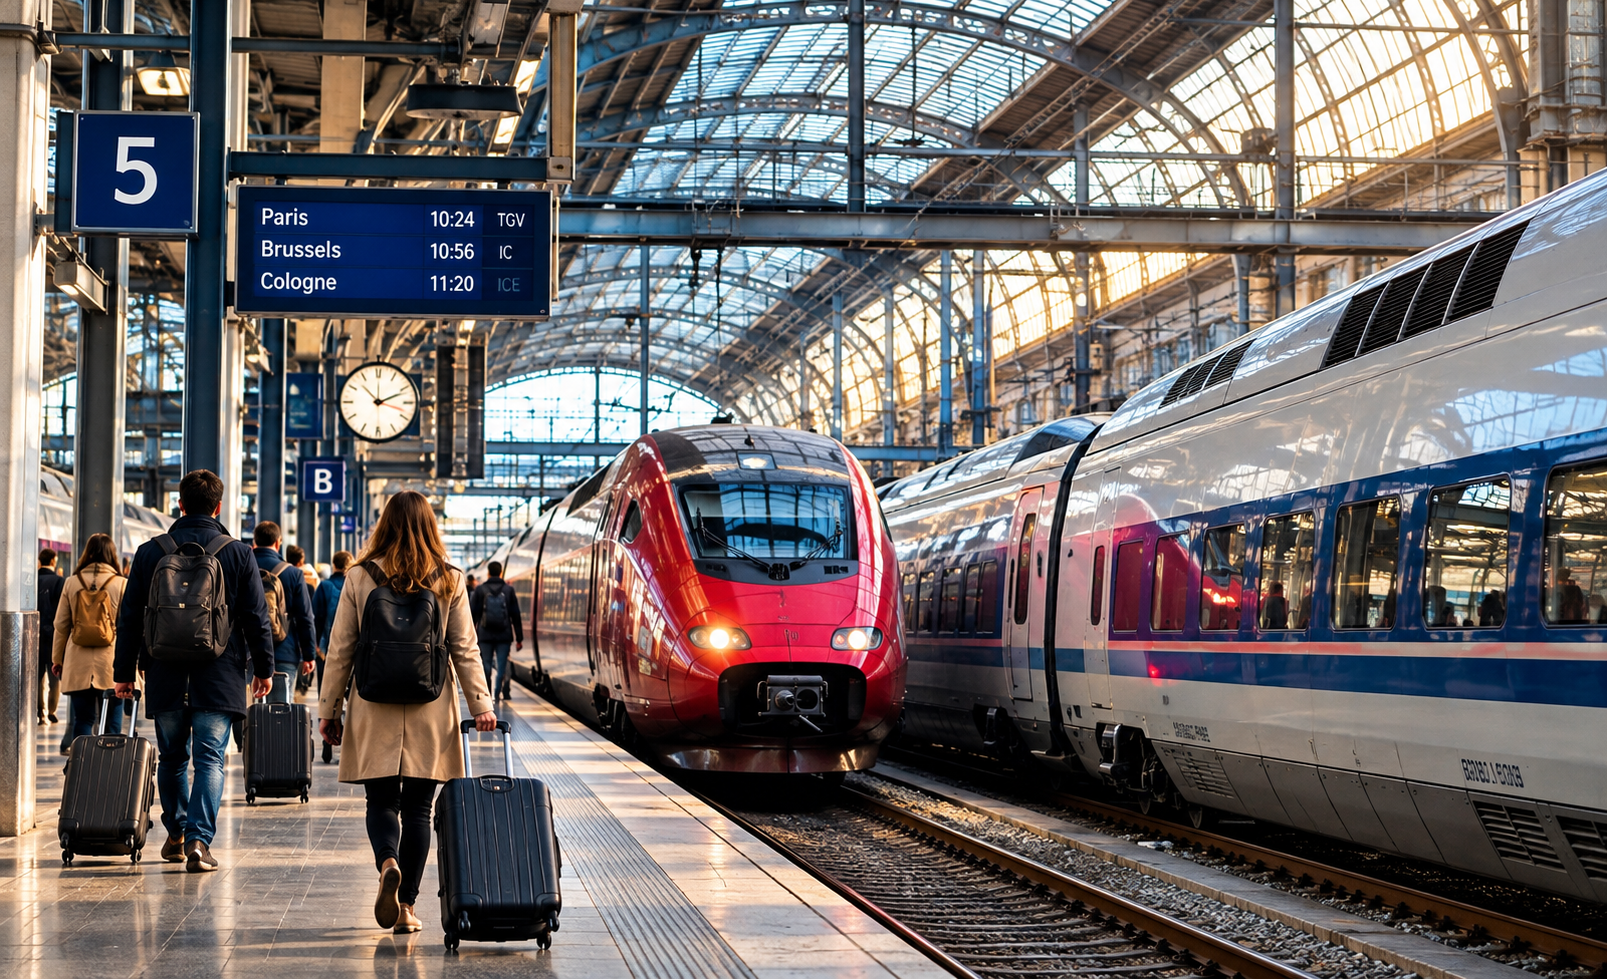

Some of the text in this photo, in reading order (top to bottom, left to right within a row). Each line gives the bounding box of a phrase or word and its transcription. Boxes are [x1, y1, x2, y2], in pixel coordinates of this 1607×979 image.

[114, 136, 158, 205] 5
[261, 208, 526, 228] Paris 10:24 TGV
[261, 239, 513, 260] Brussels 10:56 IC
[261, 271, 520, 294] Cologne 11:20 ICE
[313, 468, 333, 494] B
